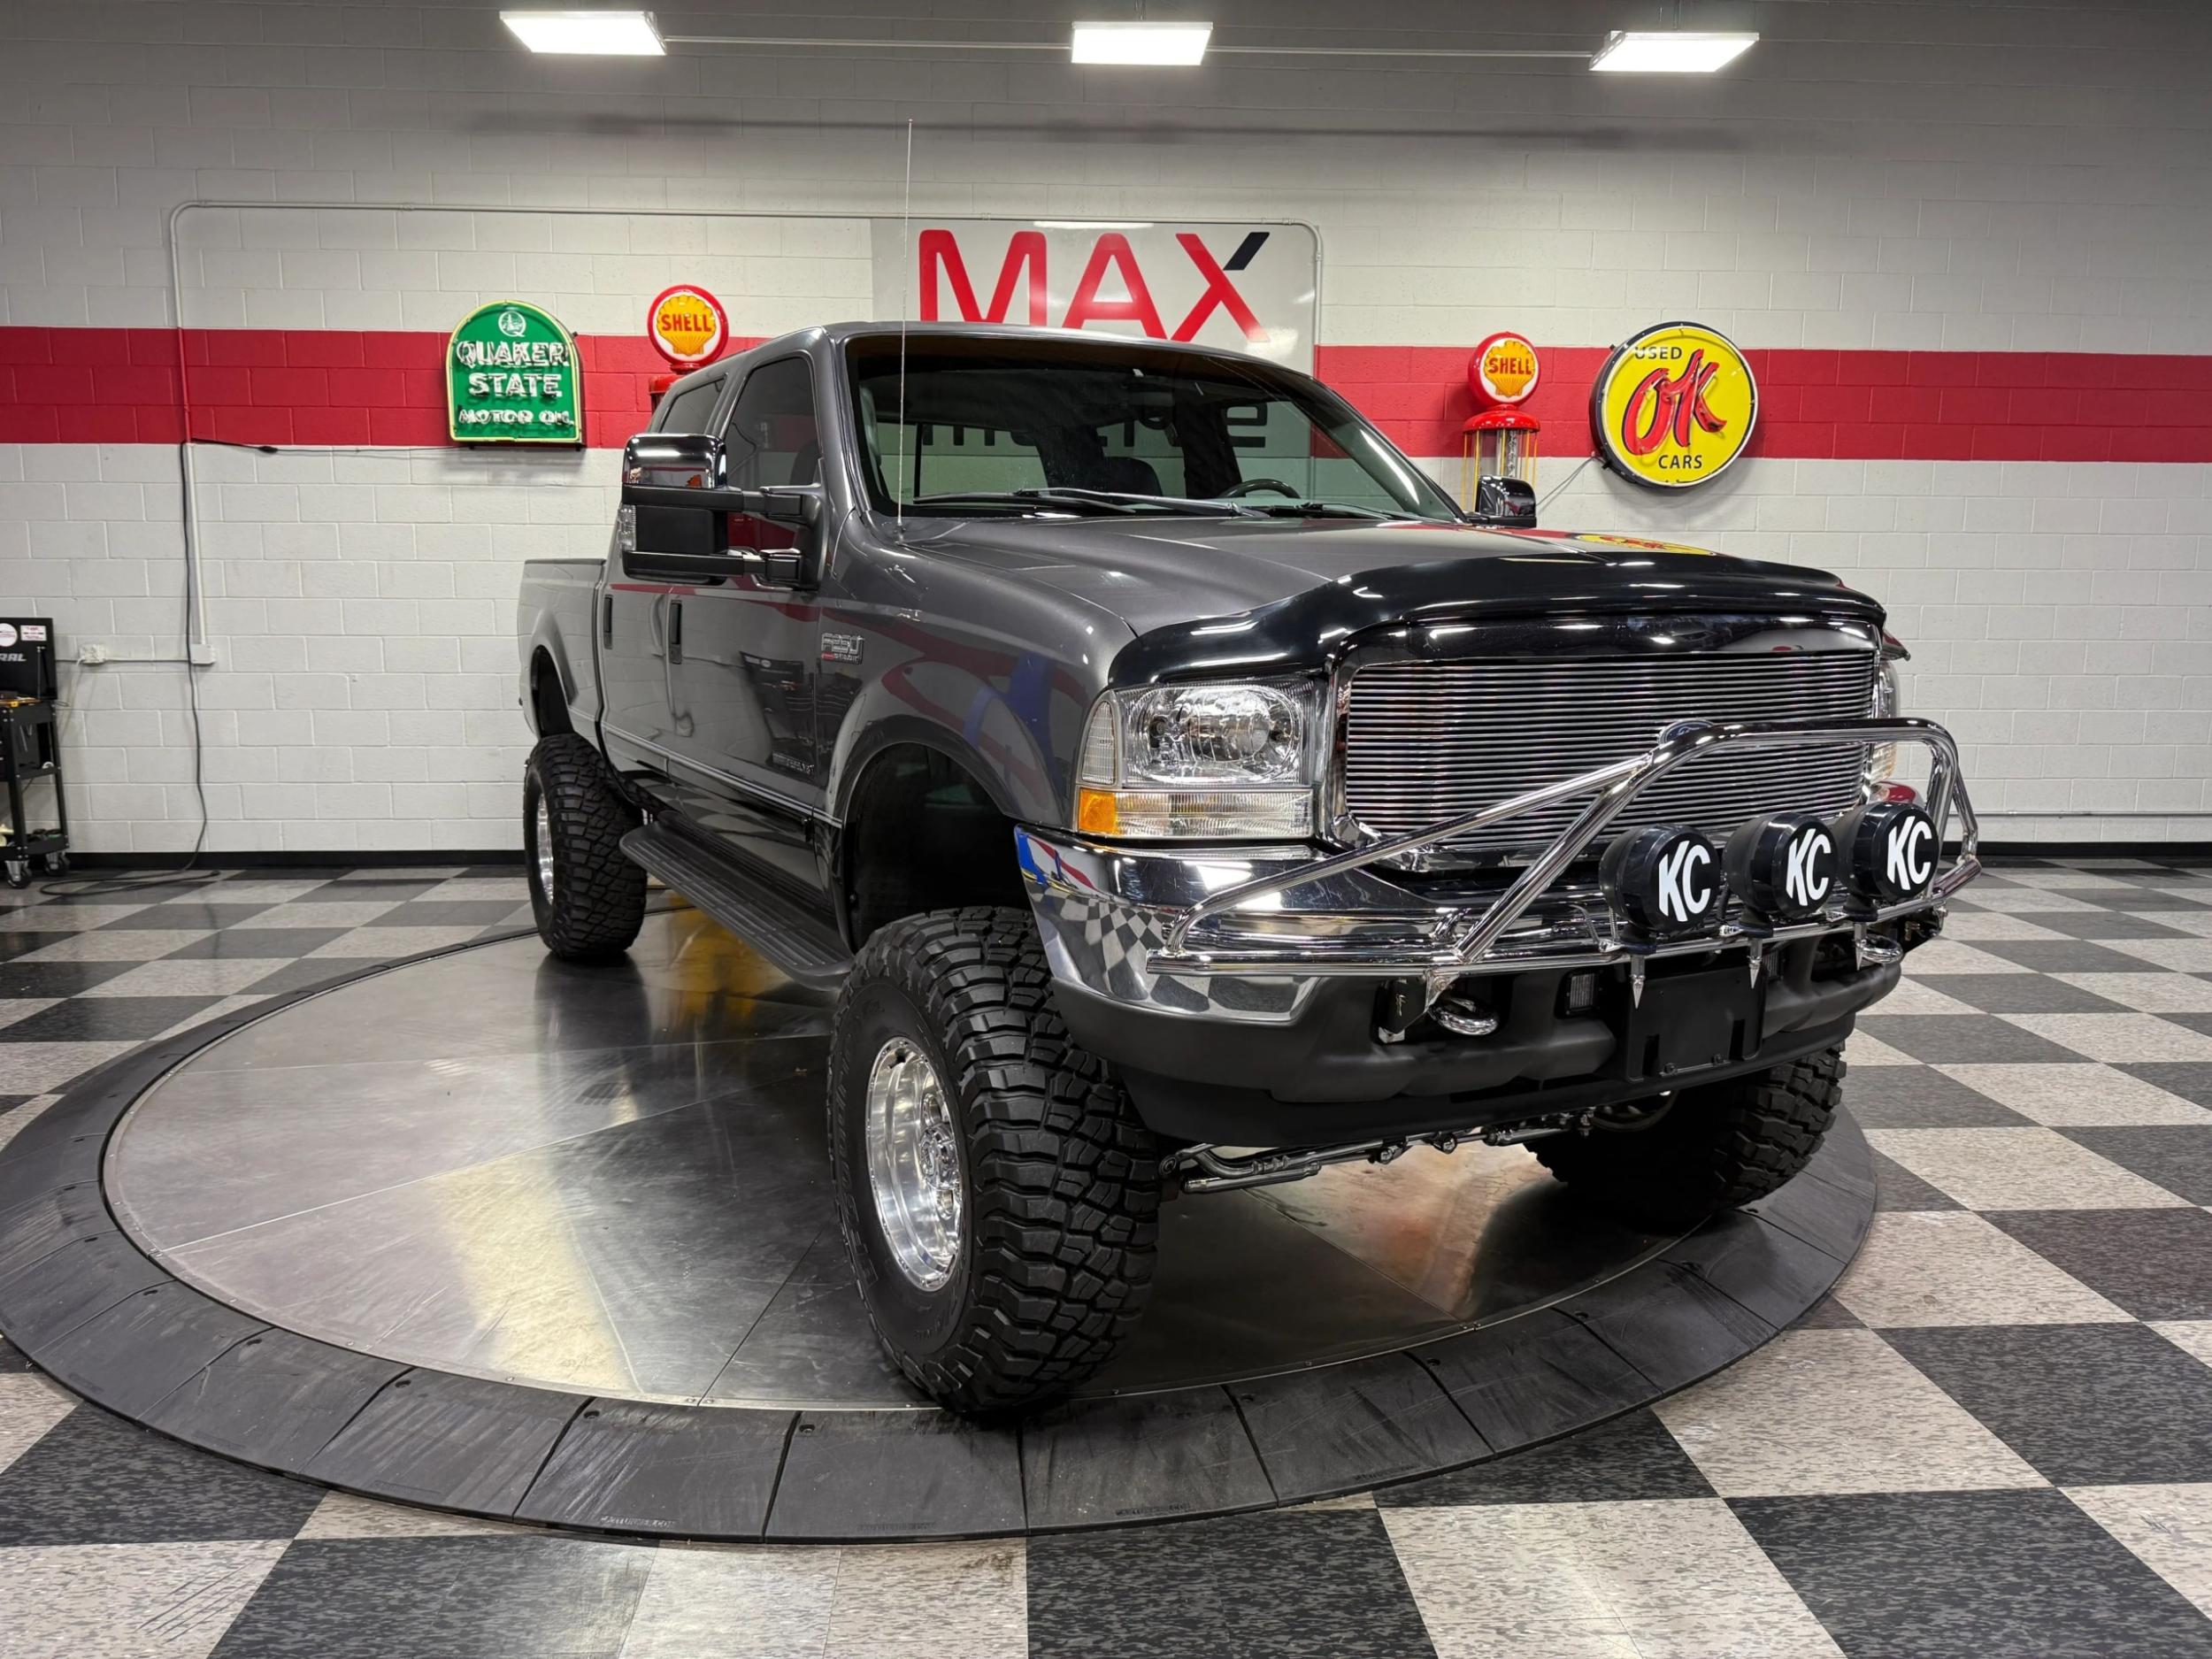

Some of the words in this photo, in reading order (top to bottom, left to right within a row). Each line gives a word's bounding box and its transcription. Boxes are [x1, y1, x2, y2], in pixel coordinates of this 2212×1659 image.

[919, 229, 1271, 342] MAX
[661, 313, 711, 332] SHELL
[457, 341, 570, 368] QUAKER
[1635, 346, 1683, 360] USED
[1487, 357, 1532, 375] SHELL
[469, 373, 563, 397] STATE
[1622, 349, 1727, 456] OK
[458, 410, 534, 425] MOTOR
[539, 410, 574, 426] OIL
[1658, 455, 1702, 469] CARS
[1886, 815, 1932, 891] KC
[1786, 828, 1832, 907] KC
[1658, 841, 1711, 922] KC
